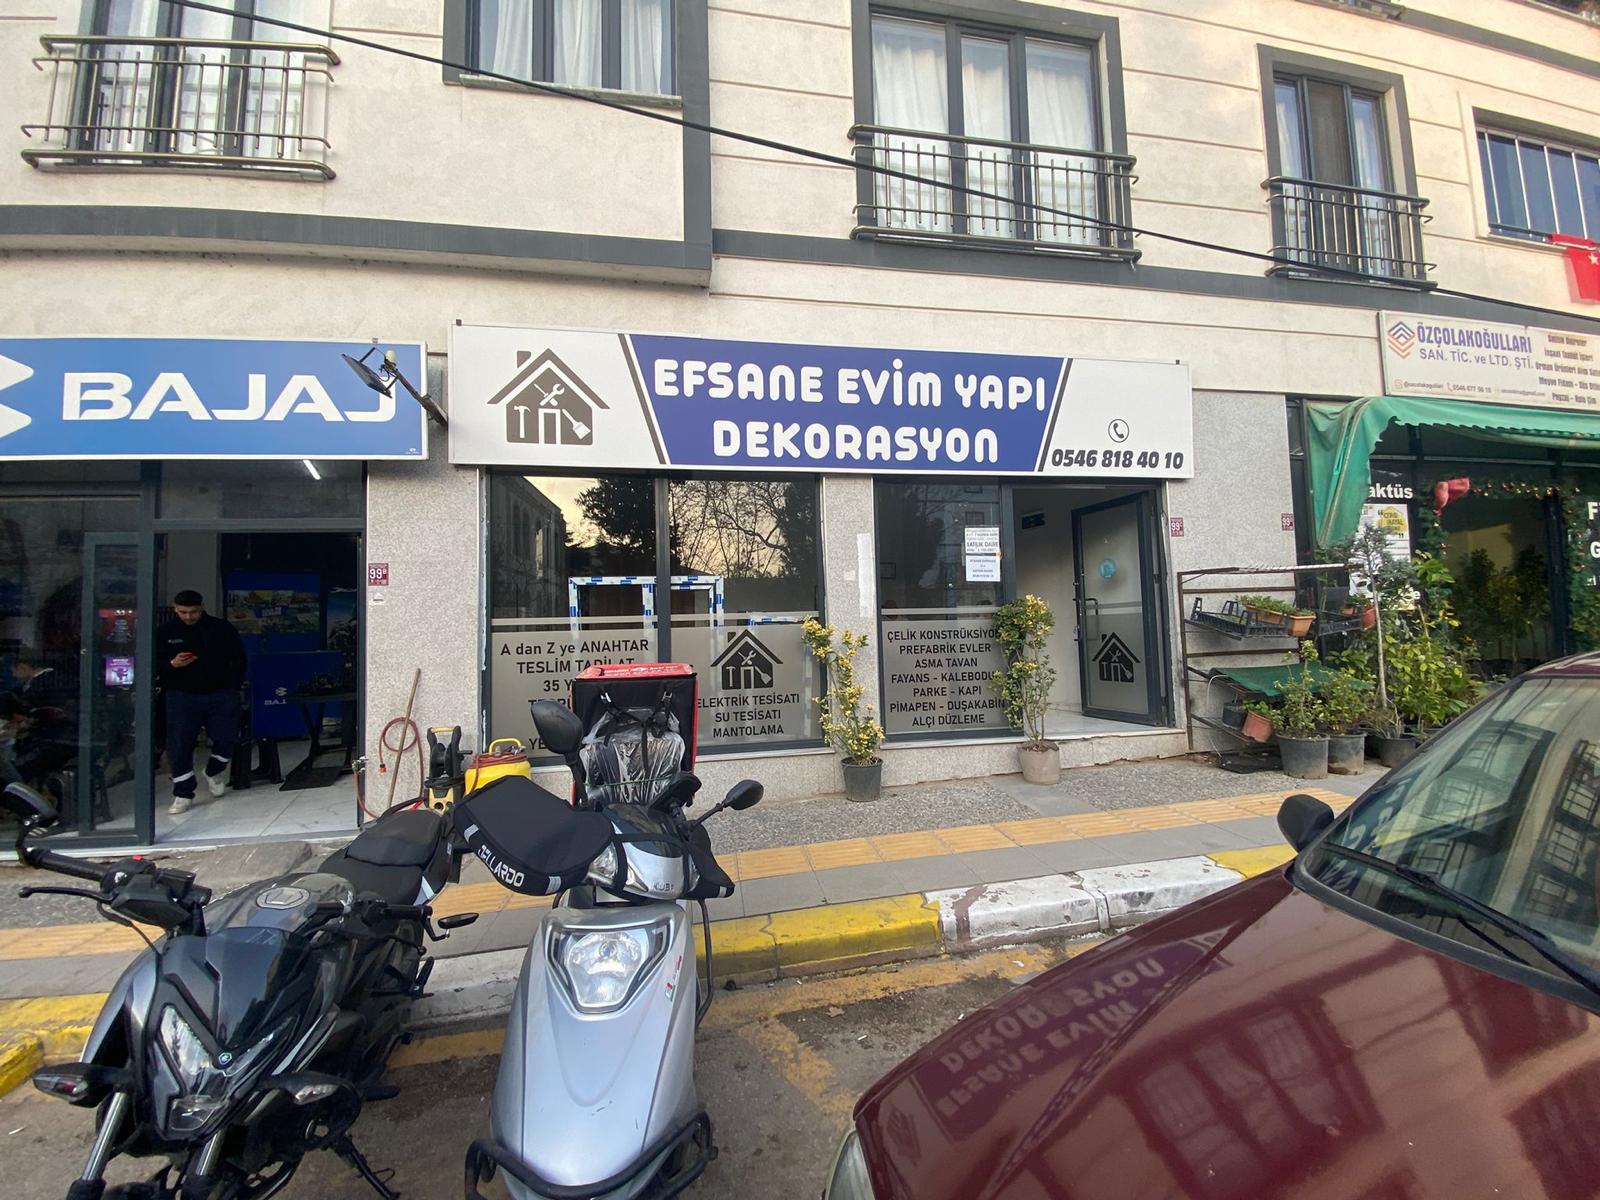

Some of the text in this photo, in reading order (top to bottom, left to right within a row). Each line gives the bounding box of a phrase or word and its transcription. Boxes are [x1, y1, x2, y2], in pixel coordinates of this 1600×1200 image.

[1417, 321, 1532, 353] ÖZÇOLAKOĞULLARI
[1419, 348, 1448, 361] SAN.
[1449, 348, 1472, 363] TİC.
[1474, 355, 1487, 364] ve
[1489, 354, 1512, 367] LTD.
[654, 358, 1045, 411] EFSANE EVİM YAPI
[62, 372, 397, 422] BAJAJ
[713, 419, 998, 464] DEKORASYON
[1051, 448, 1184, 469] 0546 818 40 10
[1368, 482, 1413, 499] aktüs
[887, 628, 917, 643] ÇELİK
[500, 639, 649, 656] A dan Z ye ANAHTAR
[899, 641, 992, 655] PREFABRİK EVLER
[516, 657, 571, 674] TESLİM
[914, 657, 978, 669] ASMA TAVAN
[543, 679, 560, 692] 35
[891, 673, 930, 684] FAYANS
[941, 671, 997, 682] KALEBODU
[697, 691, 800, 708] ELEKTRİK TESİSATI
[913, 686, 947, 698] PARKE
[958, 685, 982, 696] KAPI
[889, 700, 936, 713] PİMAPEN
[947, 697, 1005, 712] DUŞAKABİN
[715, 708, 781, 722] SU TESİSATI
[912, 713, 985, 728] ALÇI DÜZLEME
[713, 724, 784, 738] MANTOLAMA
